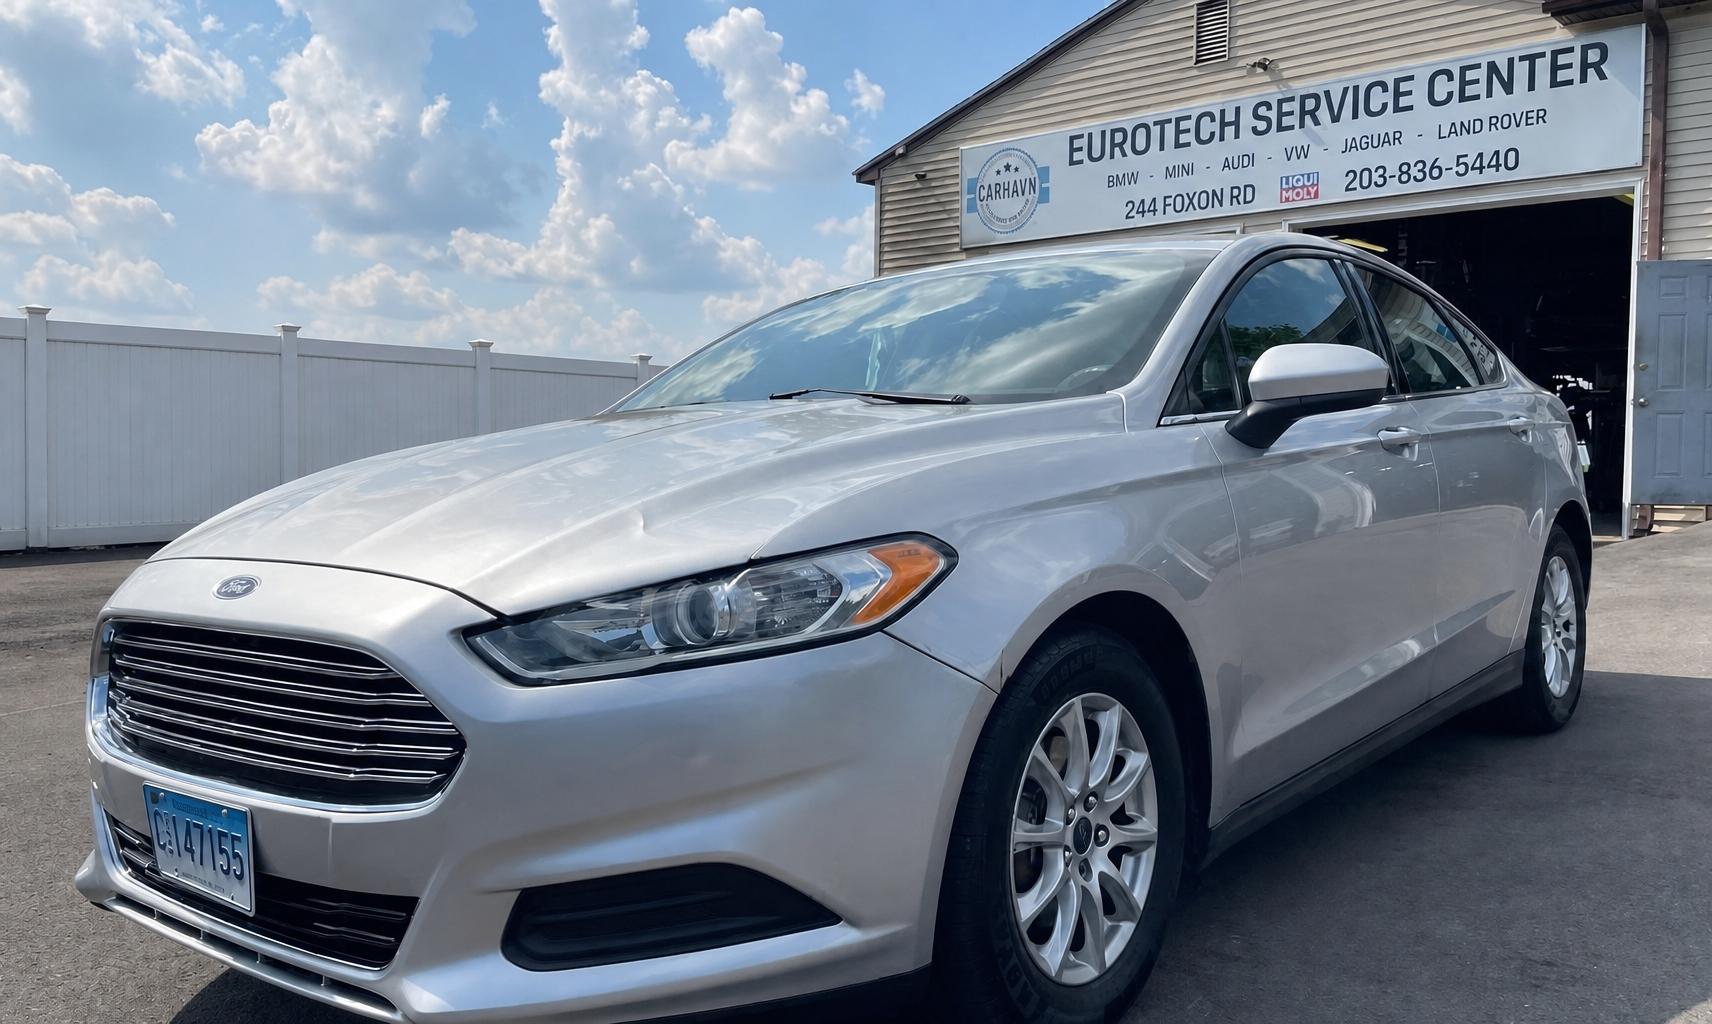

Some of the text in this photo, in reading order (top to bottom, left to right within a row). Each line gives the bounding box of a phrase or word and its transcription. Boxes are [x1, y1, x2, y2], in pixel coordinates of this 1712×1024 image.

[1069, 42, 1609, 166] EUROTECH SERVICE CENTER
[1107, 170, 1140, 188] BMW
[1165, 163, 1194, 180] MINI
[1221, 153, 1255, 172] AUDI
[1284, 144, 1310, 161] VW
[1341, 130, 1402, 154] JAGUAR
[1438, 118, 1483, 140] LAND
[1489, 108, 1547, 132] ROVER
[1280, 172, 1318, 188] LIQUI
[1344, 147, 1520, 193] 203-836-5440
[978, 177, 1037, 202] CARHAVN
[1125, 183, 1256, 220] 244 FOXON RD
[1281, 186, 1318, 202] MOLY
